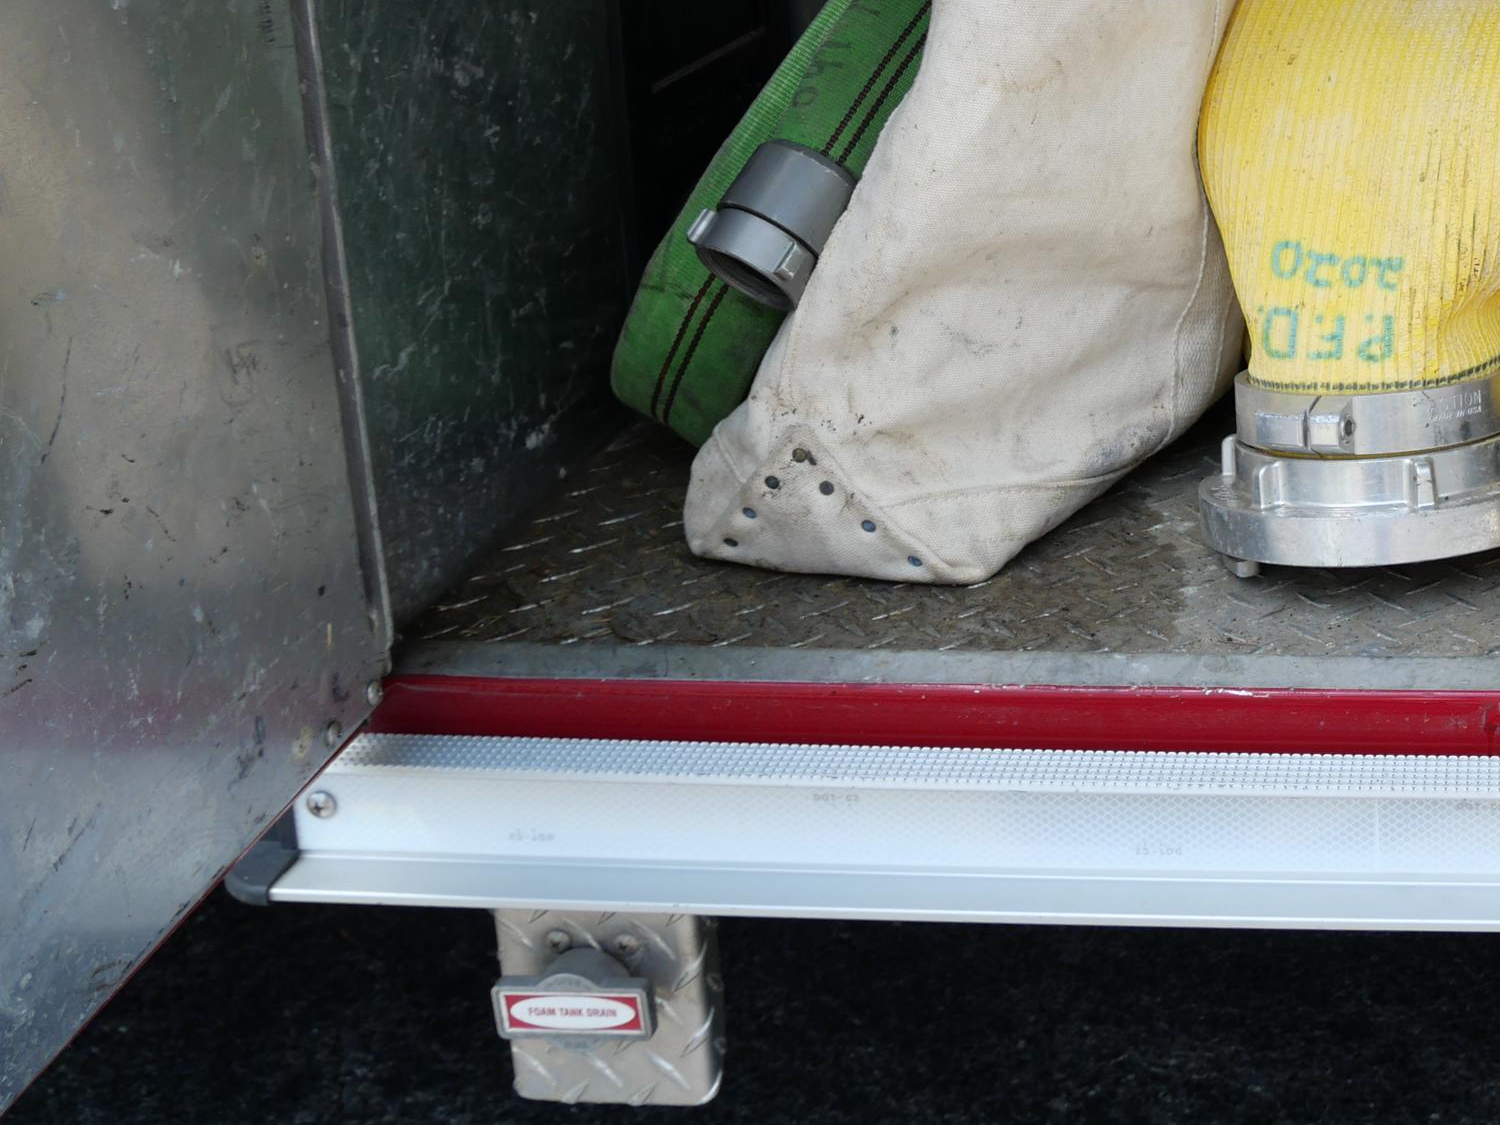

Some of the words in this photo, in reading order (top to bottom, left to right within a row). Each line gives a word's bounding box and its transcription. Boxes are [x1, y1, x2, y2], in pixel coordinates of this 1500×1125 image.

[1271, 239, 1406, 292] 2020
[528, 1007, 556, 1017] FOAM
[559, 1008, 583, 1017] TANK
[586, 1008, 618, 1018] DRAIN
